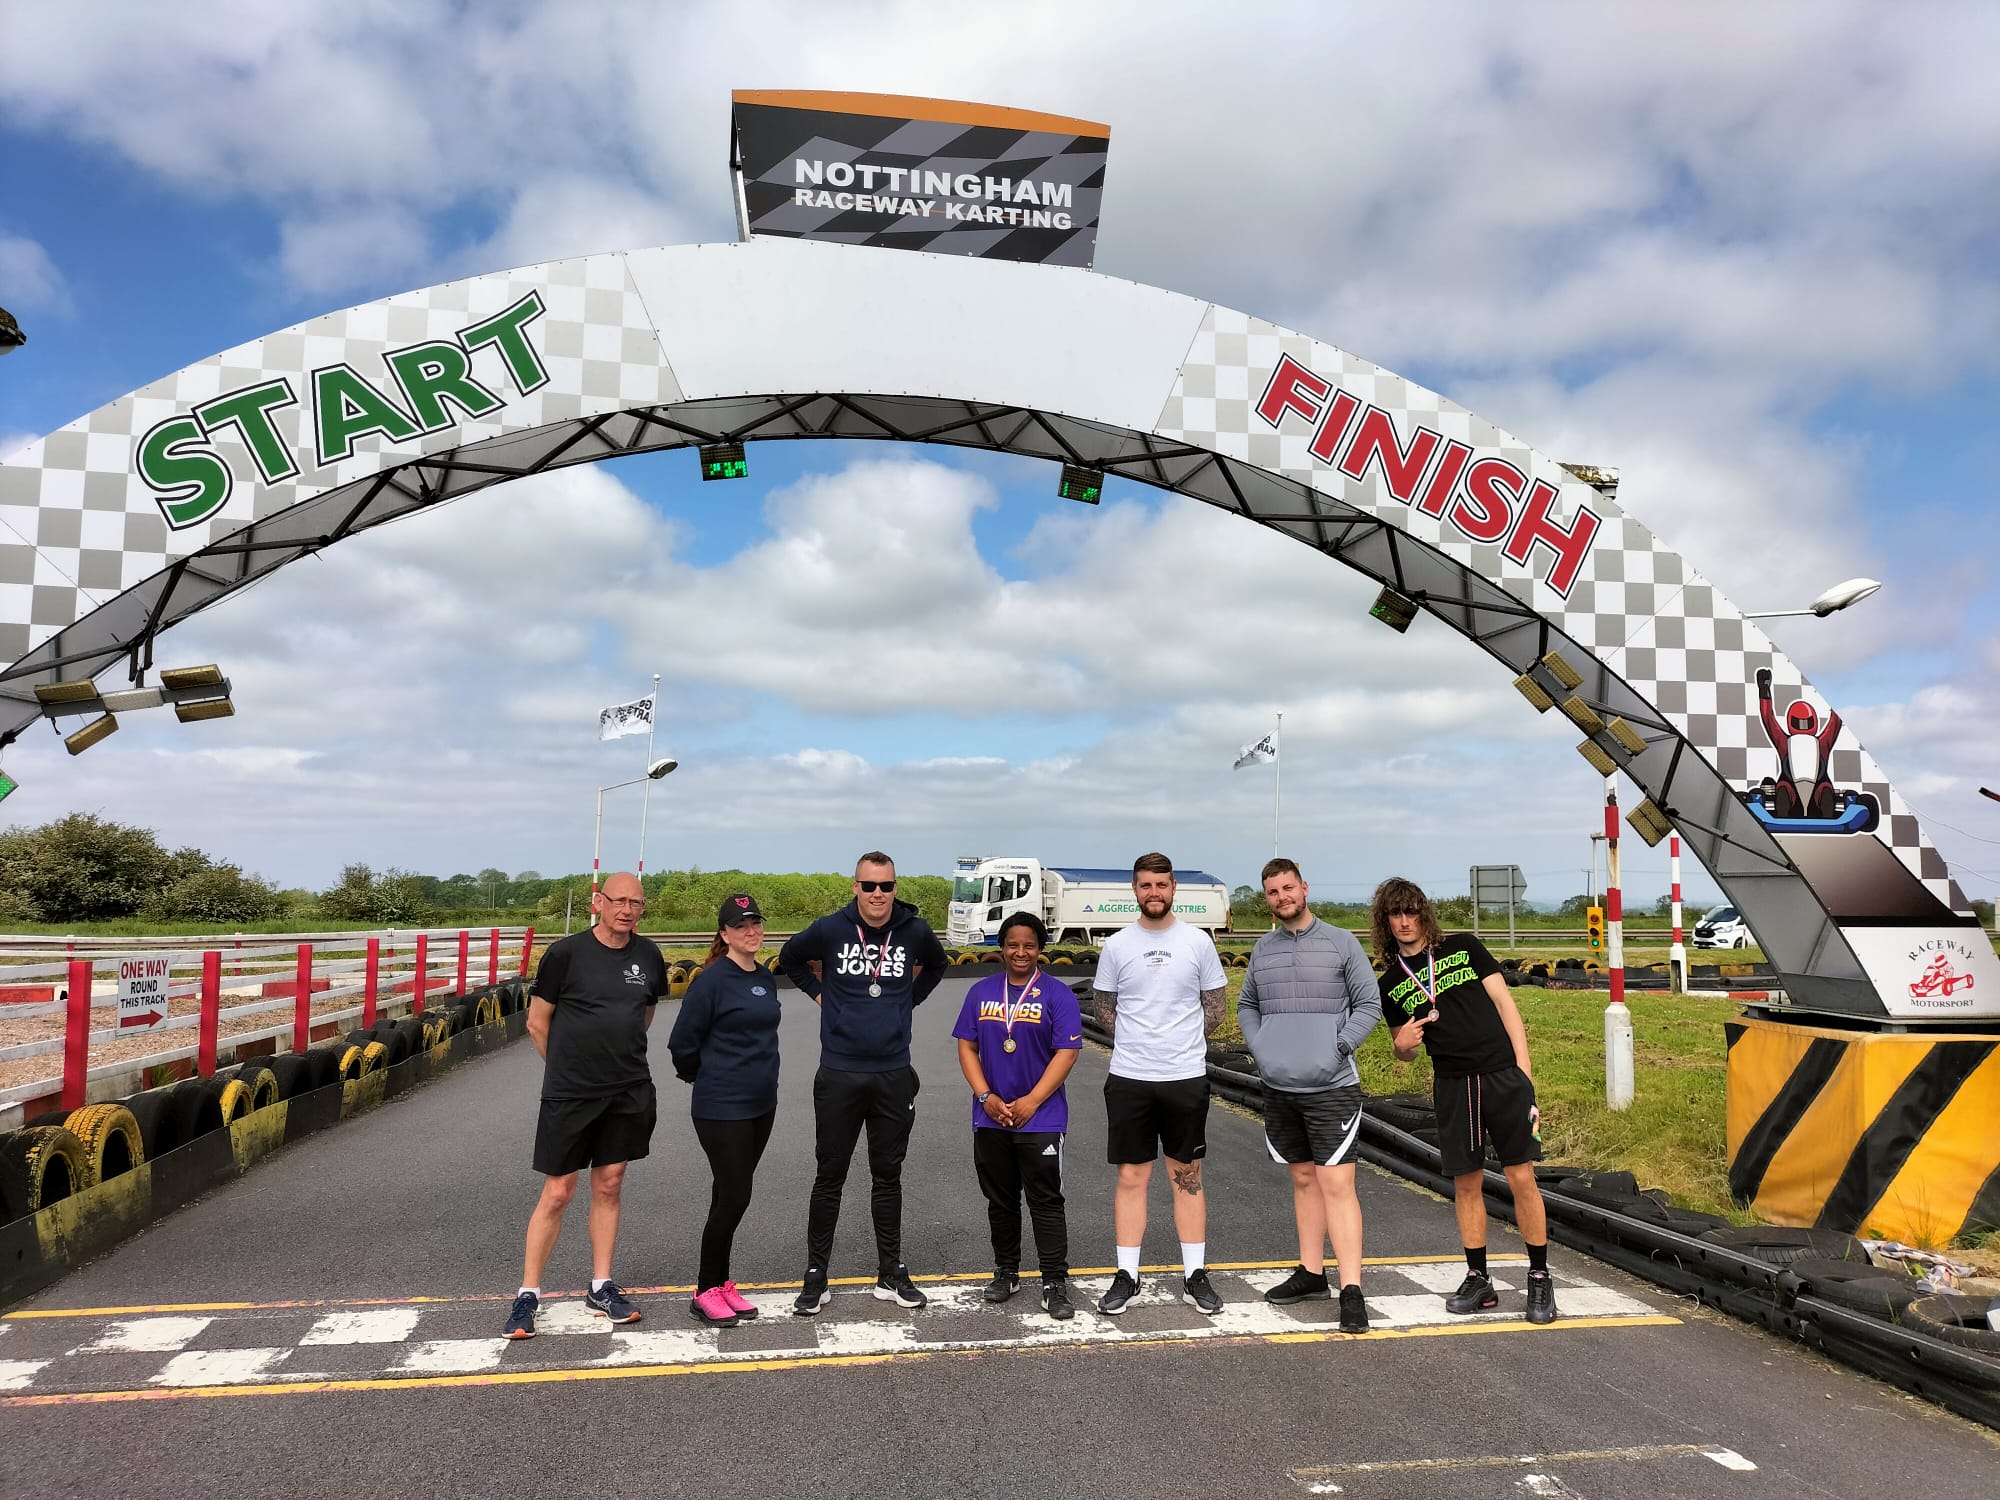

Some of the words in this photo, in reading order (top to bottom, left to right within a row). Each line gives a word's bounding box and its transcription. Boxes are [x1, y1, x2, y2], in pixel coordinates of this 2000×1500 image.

[794, 158, 1073, 208] NOTTINGHAM
[794, 188, 935, 218] RACEWAY
[945, 202, 1072, 230] KARTING
[136, 288, 551, 531] START
[1254, 352, 1602, 600] FINISH
[1097, 904, 1142, 913] AGGREGA
[1172, 905, 1207, 913] USTRIES
[1908, 939, 1975, 961] RACEWAY
[121, 961, 144, 979] ONE
[146, 960, 168, 976] WAY
[837, 958, 905, 978] JONES
[130, 980, 158, 994] ROUND
[120, 997, 139, 1008] THIS
[141, 994, 166, 1006] TRACK
[980, 1001, 1043, 1020] VIKNGS
[1910, 998, 1975, 1008] MOTORSPORT
